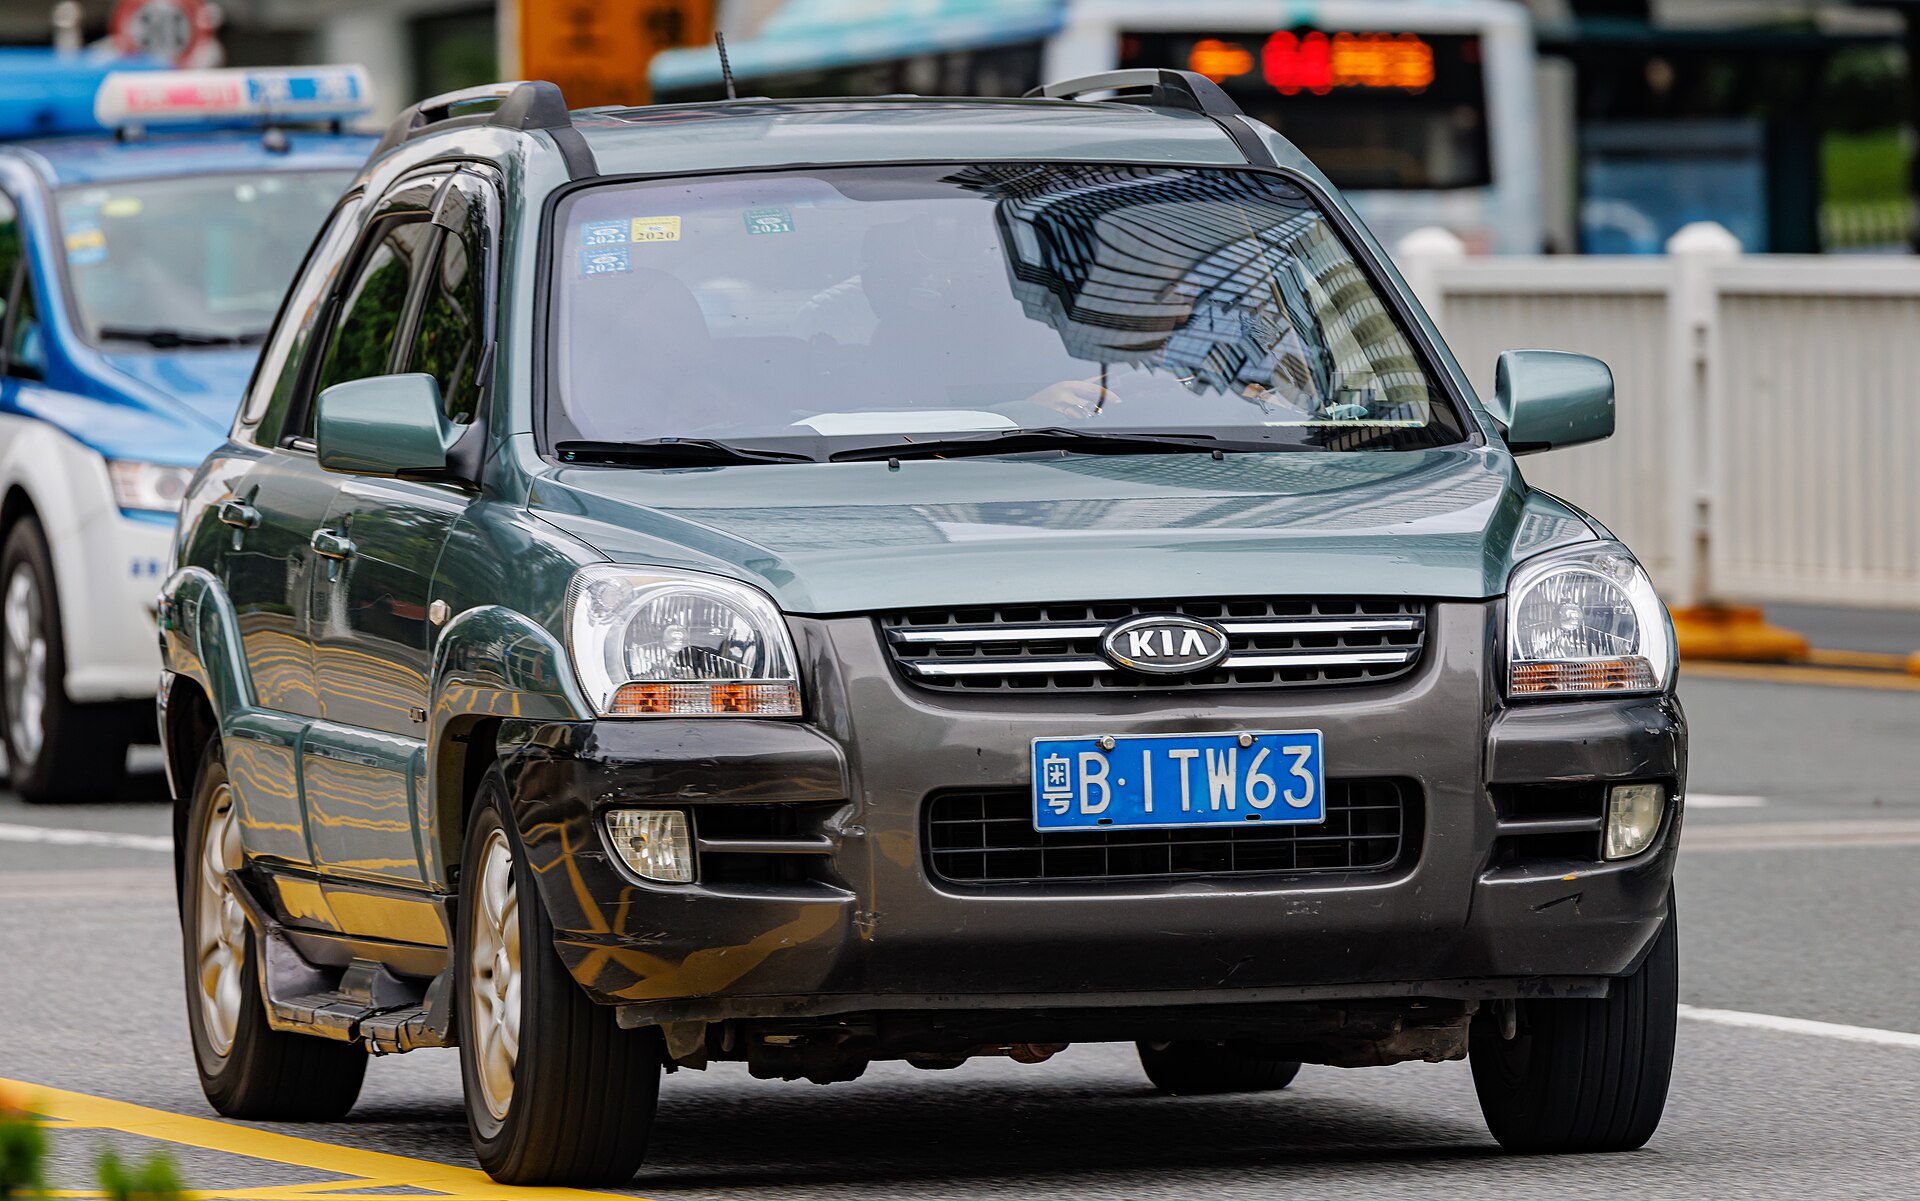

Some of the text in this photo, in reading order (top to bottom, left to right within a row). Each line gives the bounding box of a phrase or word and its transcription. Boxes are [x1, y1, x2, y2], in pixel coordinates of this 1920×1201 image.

[751, 223, 790, 234] 2021
[586, 233, 626, 245] 2022
[636, 231, 675, 241] 2020
[585, 262, 626, 274] 2022
[1127, 629, 1209, 658] KIA
